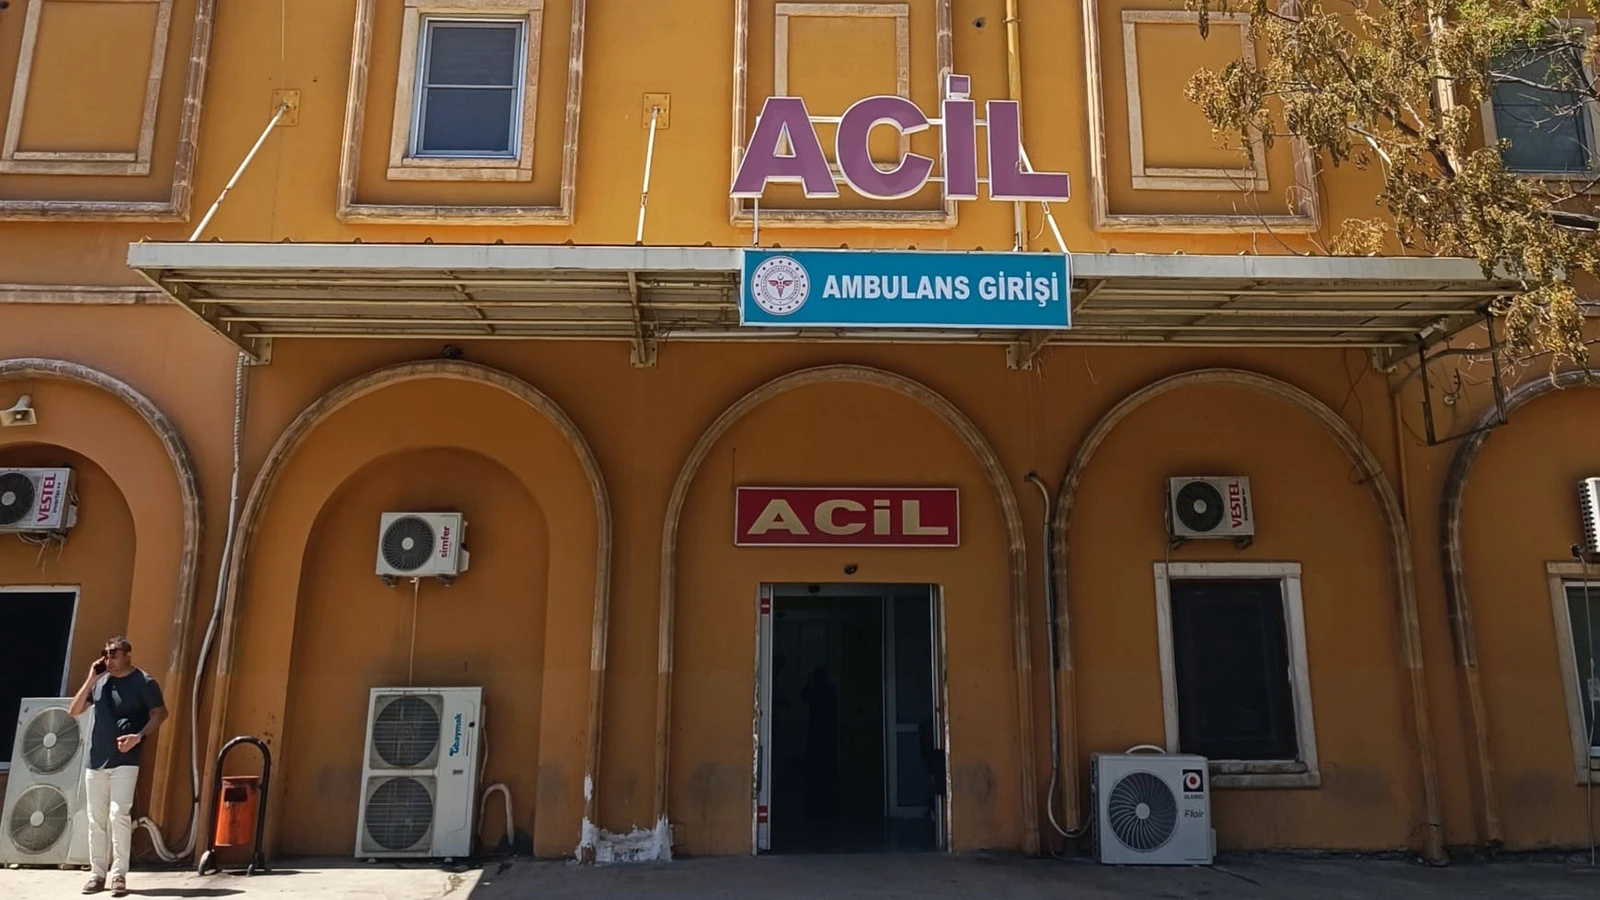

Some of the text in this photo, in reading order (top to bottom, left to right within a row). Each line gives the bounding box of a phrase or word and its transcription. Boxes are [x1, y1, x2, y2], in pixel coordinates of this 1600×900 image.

[730, 73, 1070, 202] ACİL
[822, 274, 970, 300] AMBULANS
[978, 271, 1059, 307] GİRİŞİ
[37, 473, 57, 523] VESTEL
[1228, 481, 1243, 529] VESTEL
[439, 525, 451, 559] simfer
[1184, 809, 1204, 818] Flair
